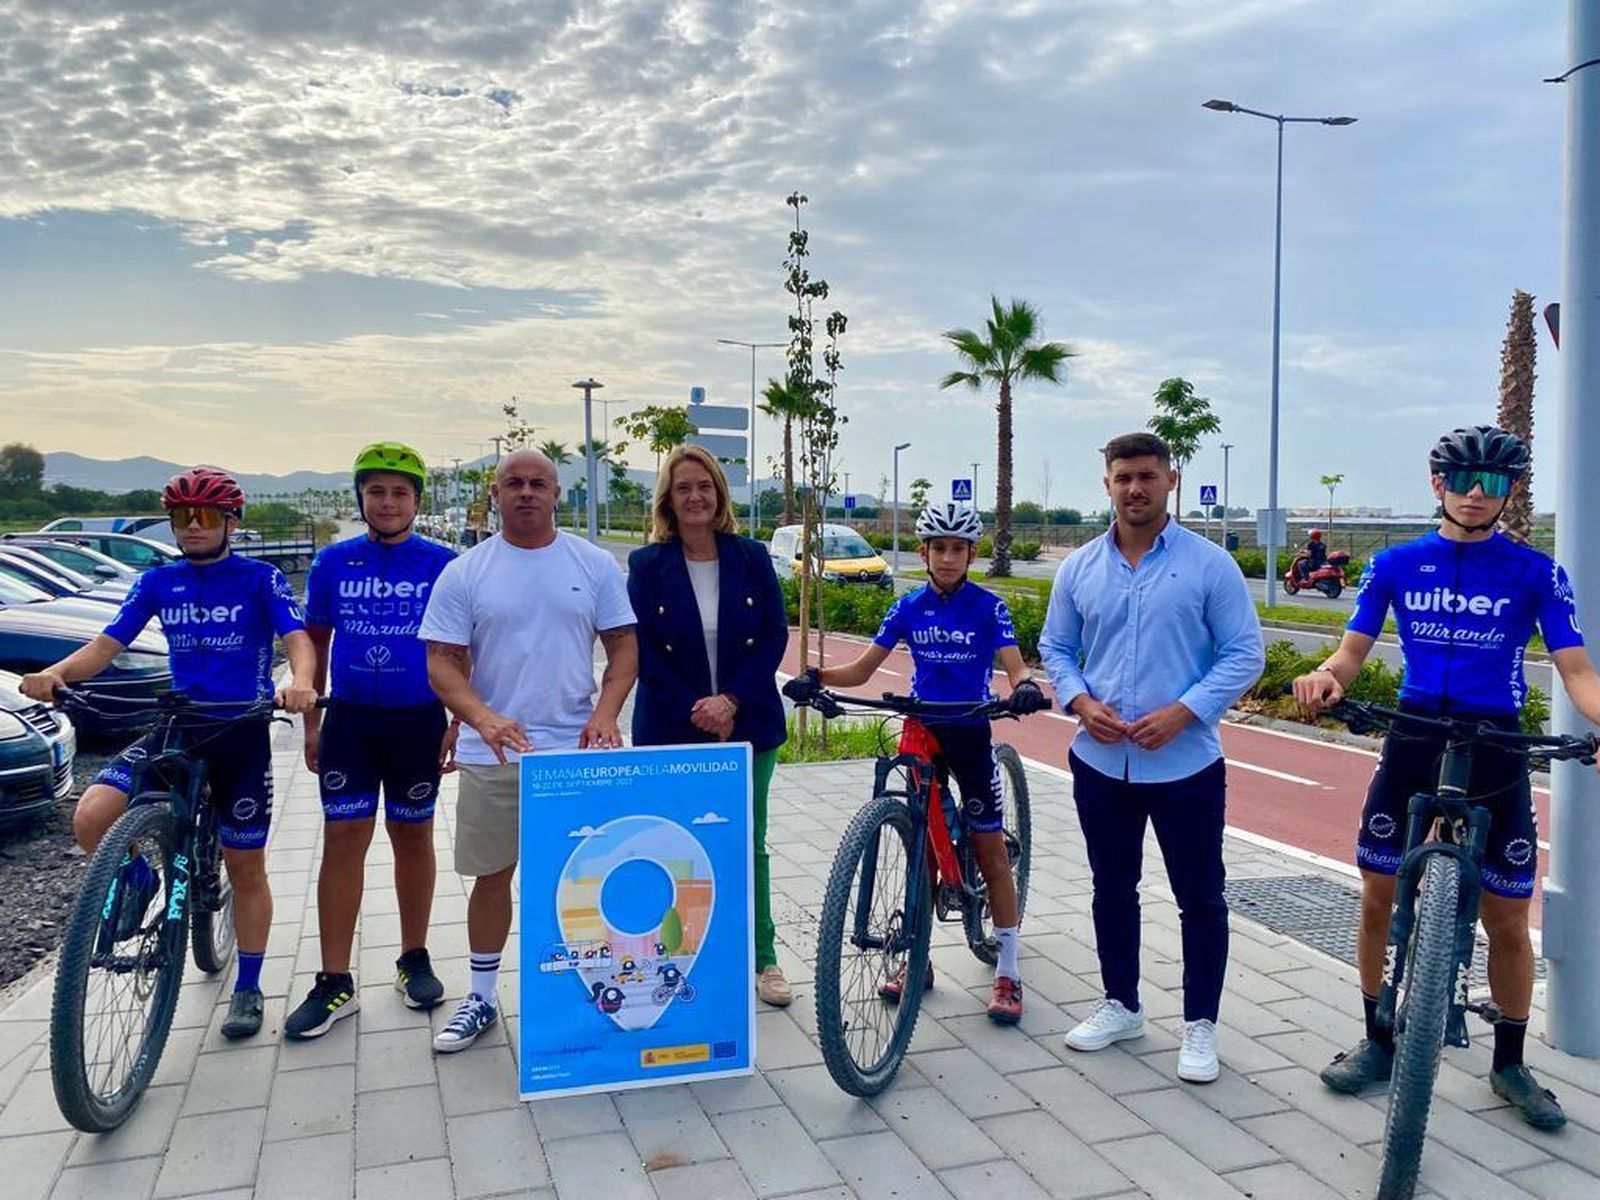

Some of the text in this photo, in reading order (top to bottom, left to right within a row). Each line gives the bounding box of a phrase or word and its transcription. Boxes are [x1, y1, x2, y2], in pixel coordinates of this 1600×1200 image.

[339, 576, 429, 598] wiber
[1404, 587, 1510, 617] wiber
[161, 602, 244, 625] wiber
[169, 631, 245, 648] Miranda
[912, 625, 976, 645] wiber
[1410, 621, 1505, 643] Miranda
